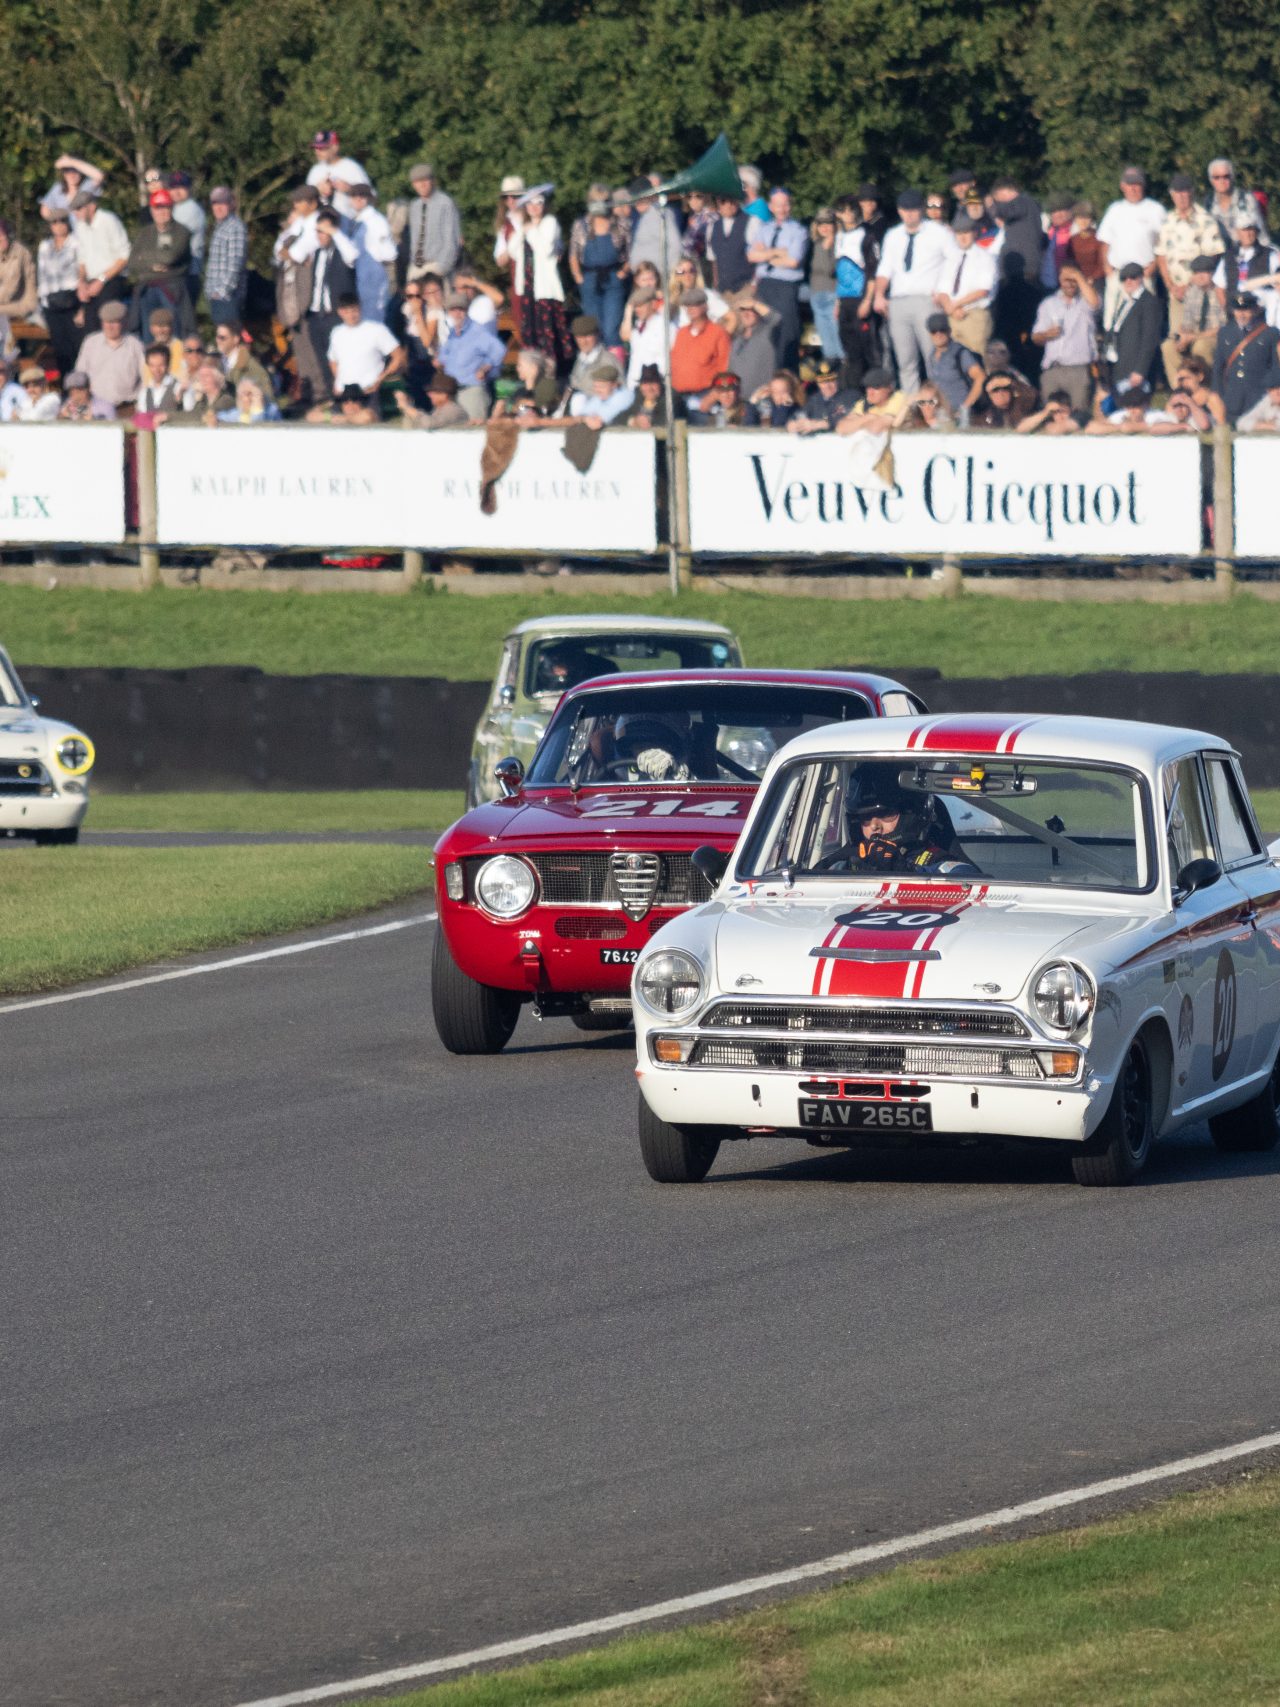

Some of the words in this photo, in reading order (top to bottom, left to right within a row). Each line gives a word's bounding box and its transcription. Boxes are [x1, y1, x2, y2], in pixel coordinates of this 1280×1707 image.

[190, 476, 267, 496] RALPH
[277, 476, 375, 497] LAUREN
[534, 479, 623, 501] LAUREN
[744, 454, 904, 524] Veuve
[922, 453, 1146, 541] Clicquot
[0, 495, 51, 519] EX
[578, 799, 740, 818] 214
[848, 911, 943, 926] 20
[519, 930, 541, 939] TOW
[1214, 974, 1234, 1057] 20
[803, 1103, 851, 1124] FAV
[861, 1106, 927, 1127] 265C
